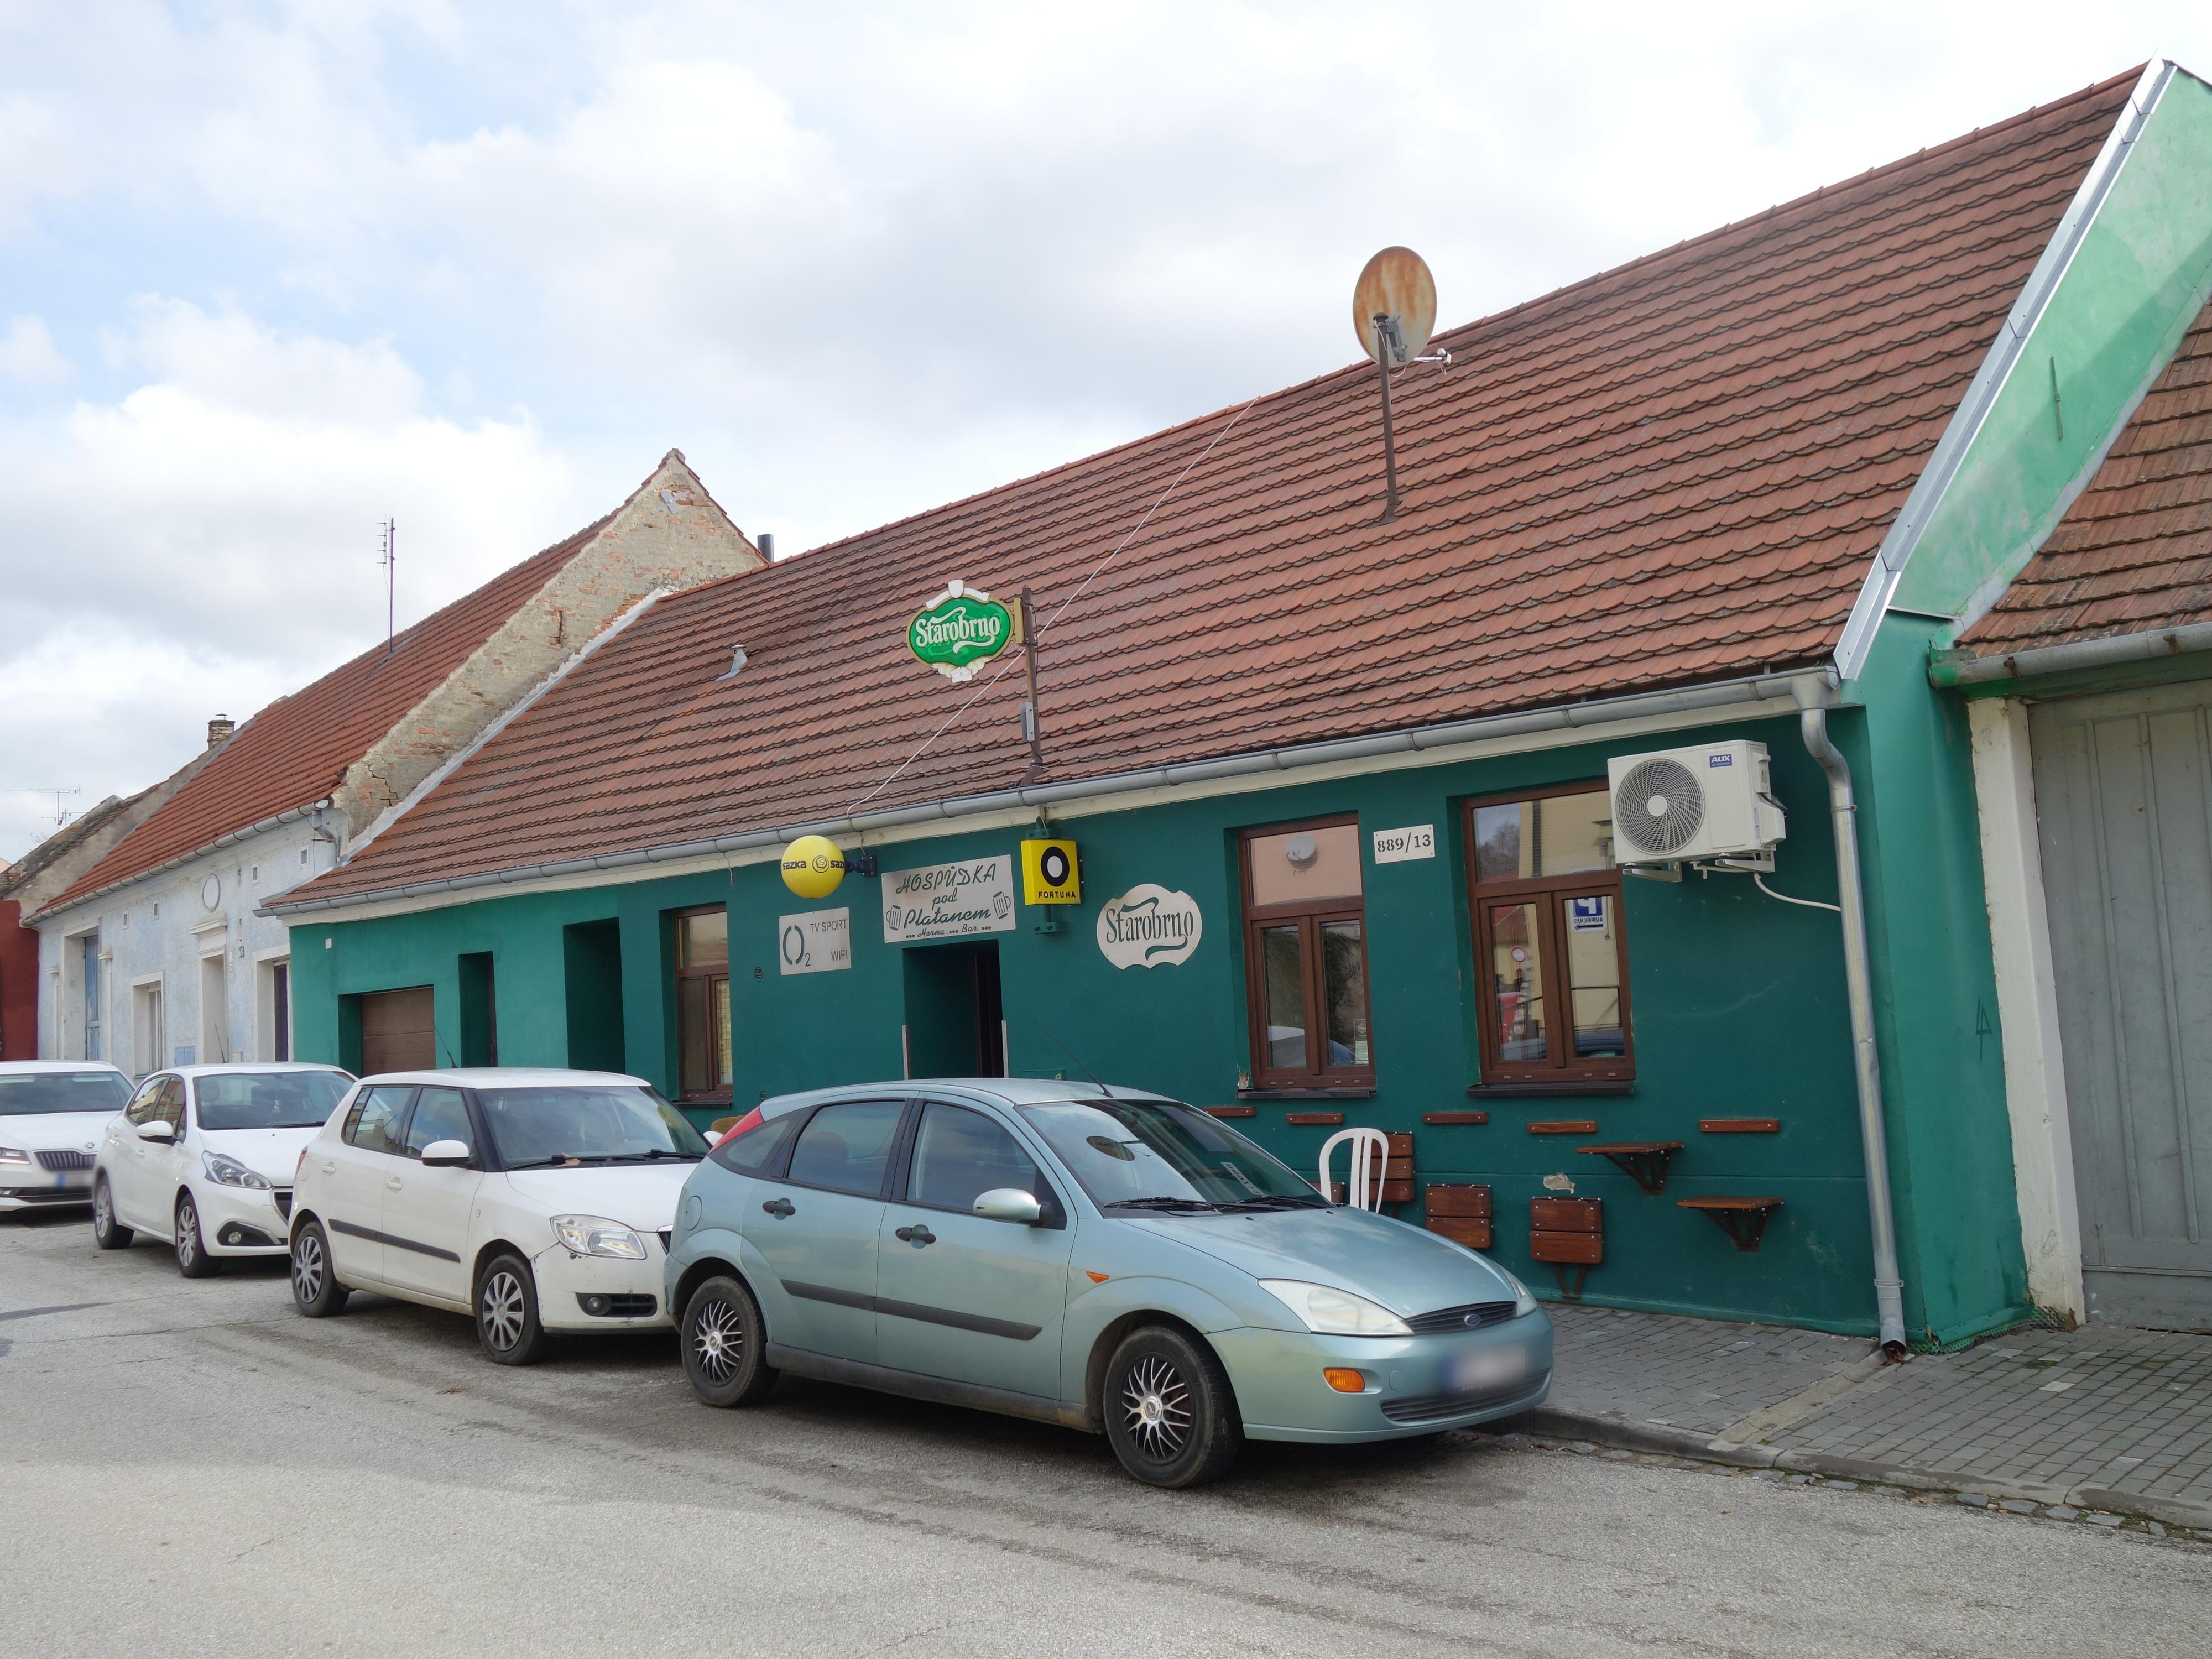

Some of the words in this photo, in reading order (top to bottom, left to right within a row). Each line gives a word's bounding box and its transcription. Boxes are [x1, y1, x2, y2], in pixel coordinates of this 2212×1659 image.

[915, 606, 1000, 654] Starobrno
[1377, 832, 1431, 853] 889/13
[931, 886, 958, 911] pod
[810, 922, 820, 933] TV
[821, 919, 847, 932] SPORT
[903, 906, 992, 930] Platanem
[1105, 896, 1194, 961] Starobrno
[917, 927, 946, 937] Herna
[961, 923, 978, 933] Bar
[831, 949, 848, 962] WIFI
